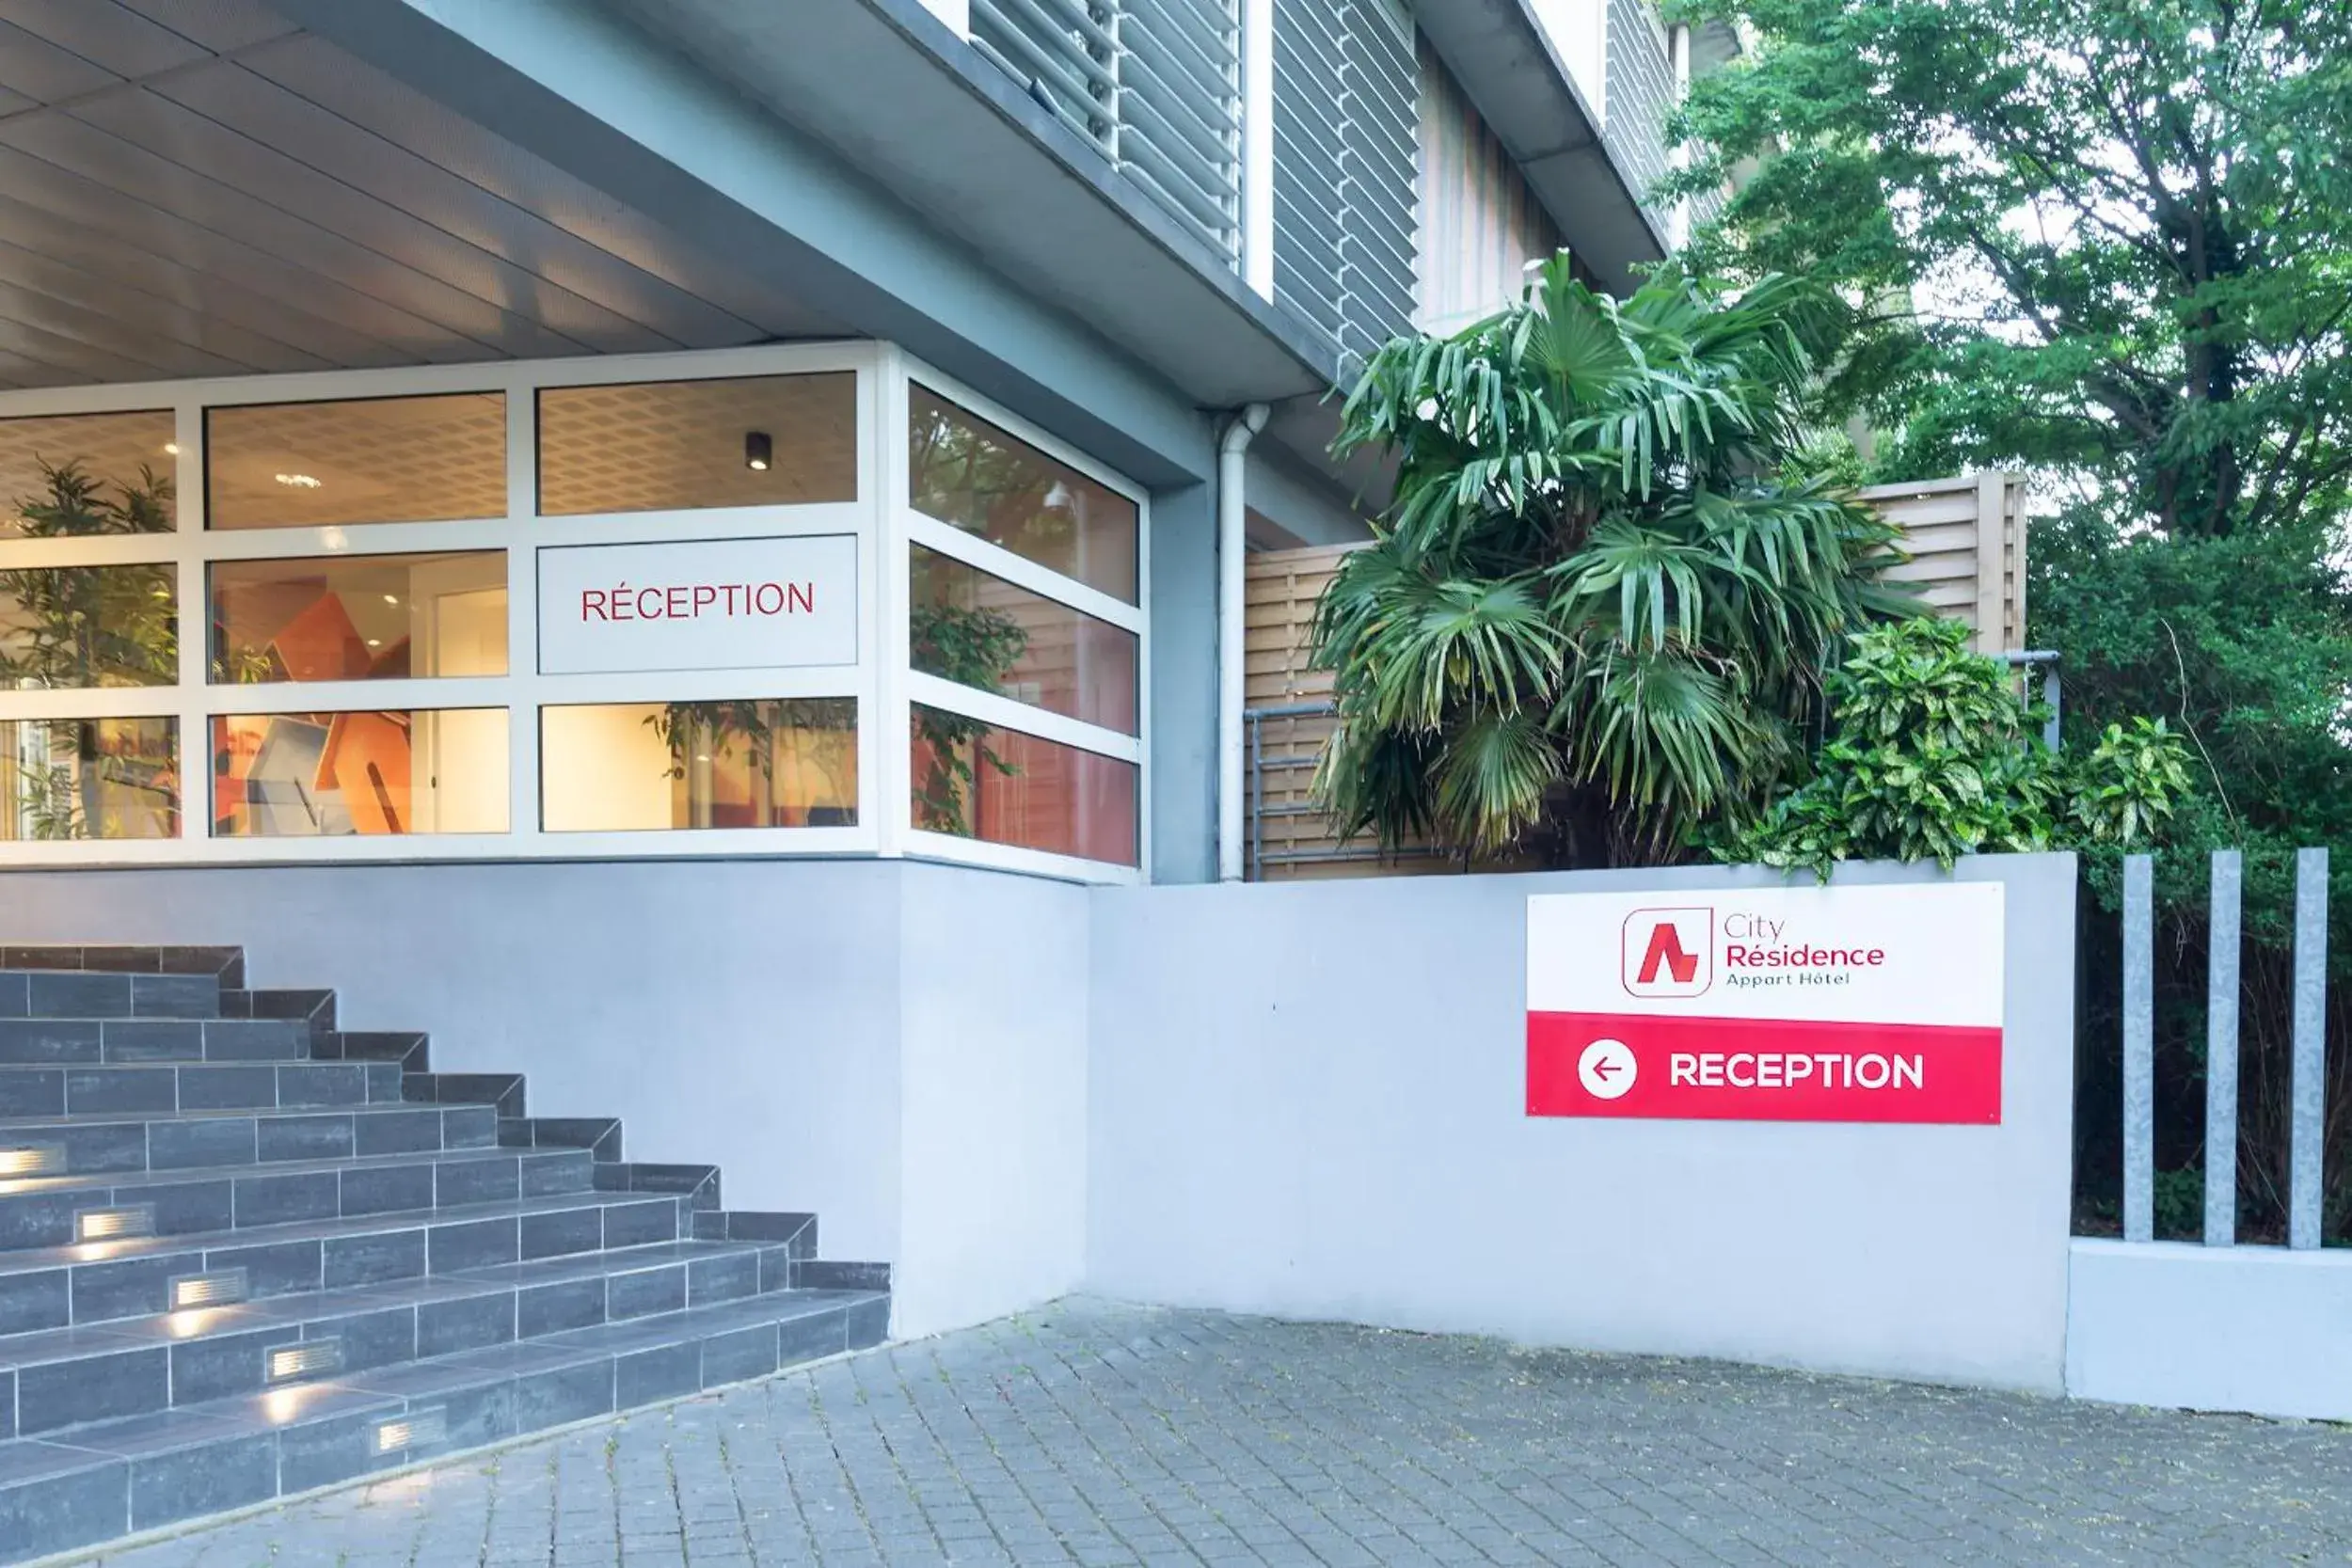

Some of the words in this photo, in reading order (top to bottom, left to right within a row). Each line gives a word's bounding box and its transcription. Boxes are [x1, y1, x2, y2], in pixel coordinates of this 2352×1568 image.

[581, 581, 813, 621] RÉCEPTION
[1724, 912, 1786, 943] City
[1727, 943, 1884, 967] Résidence
[1726, 974, 1792, 988] Appart
[1800, 973, 1850, 985] Hôtel
[1671, 1053, 1924, 1088] RECEPTION
